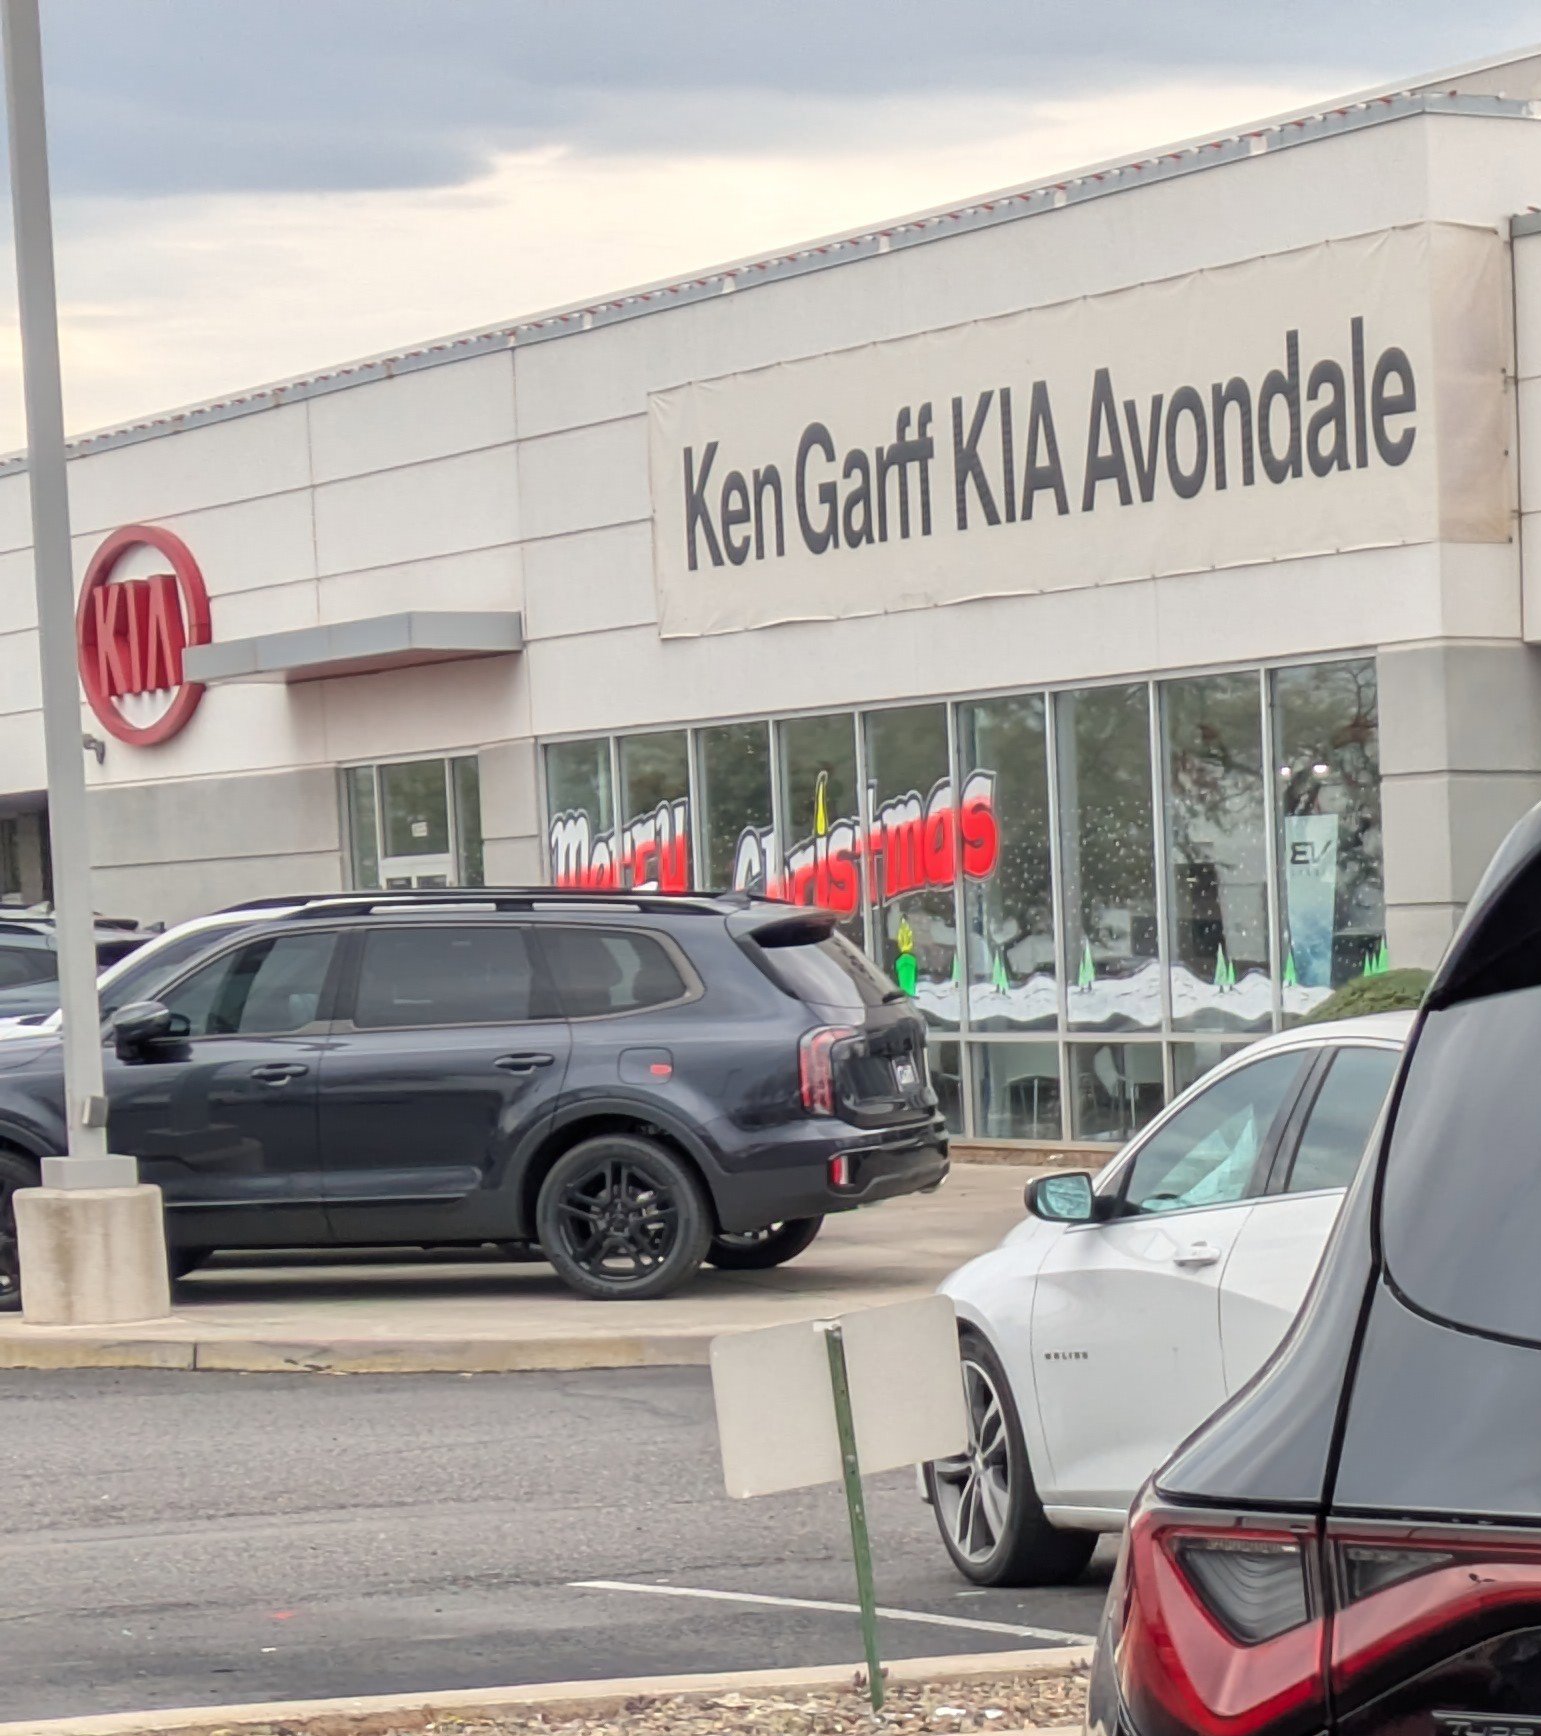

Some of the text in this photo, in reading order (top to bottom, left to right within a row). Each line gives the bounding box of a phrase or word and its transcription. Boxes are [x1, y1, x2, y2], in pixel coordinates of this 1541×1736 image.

[683, 315, 1417, 571] Ken Garff KIA Avondale
[93, 574, 184, 699] KIA
